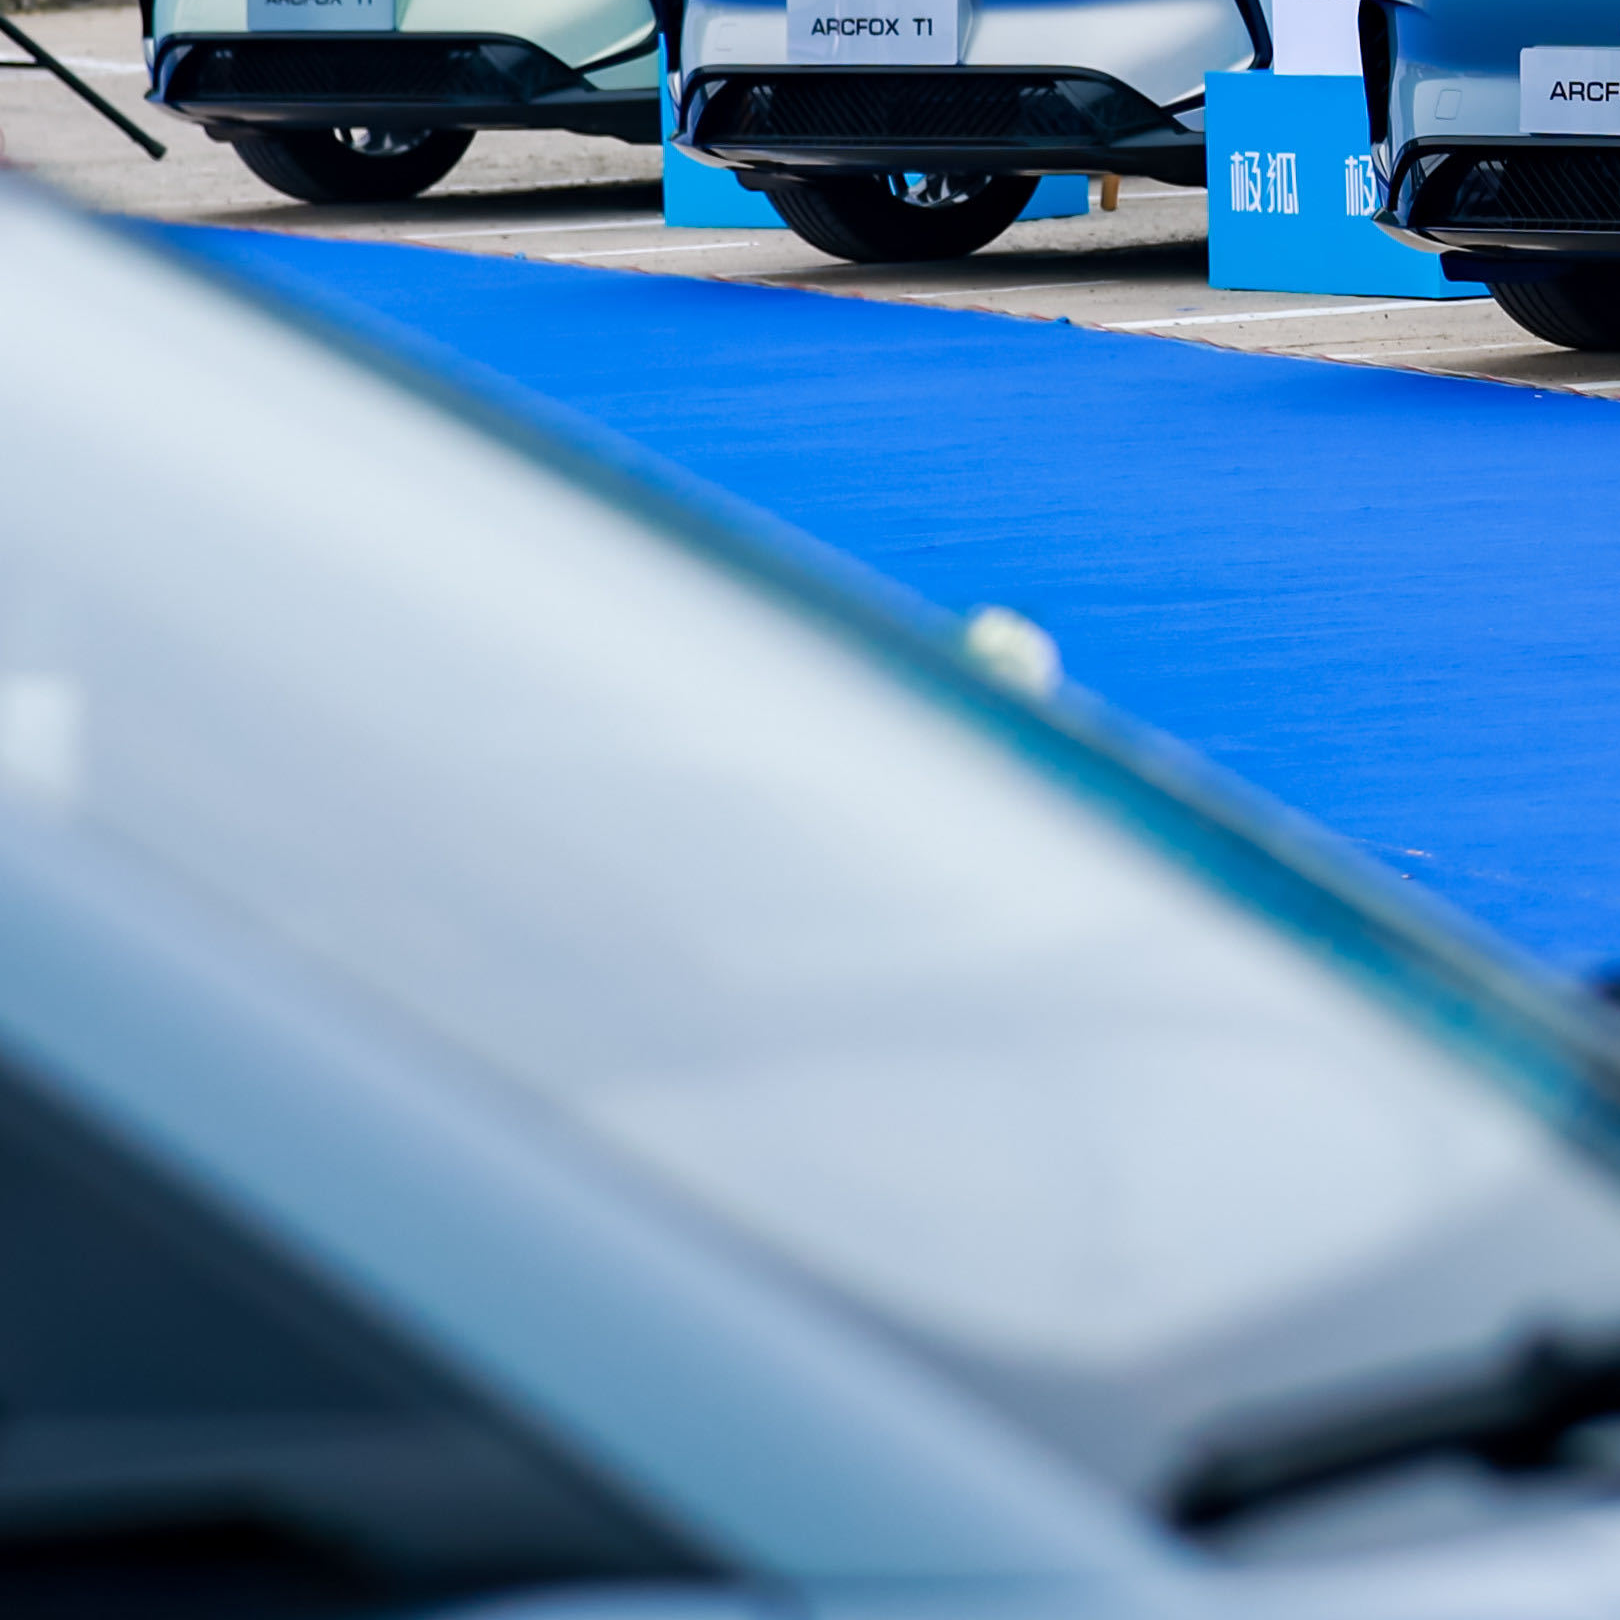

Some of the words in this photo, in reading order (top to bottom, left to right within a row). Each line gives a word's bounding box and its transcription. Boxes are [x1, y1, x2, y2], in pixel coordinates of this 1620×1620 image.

[811, 17, 900, 36] ARCFOX
[912, 17, 933, 36] T1
[1230, 151, 1299, 215] 极狐
